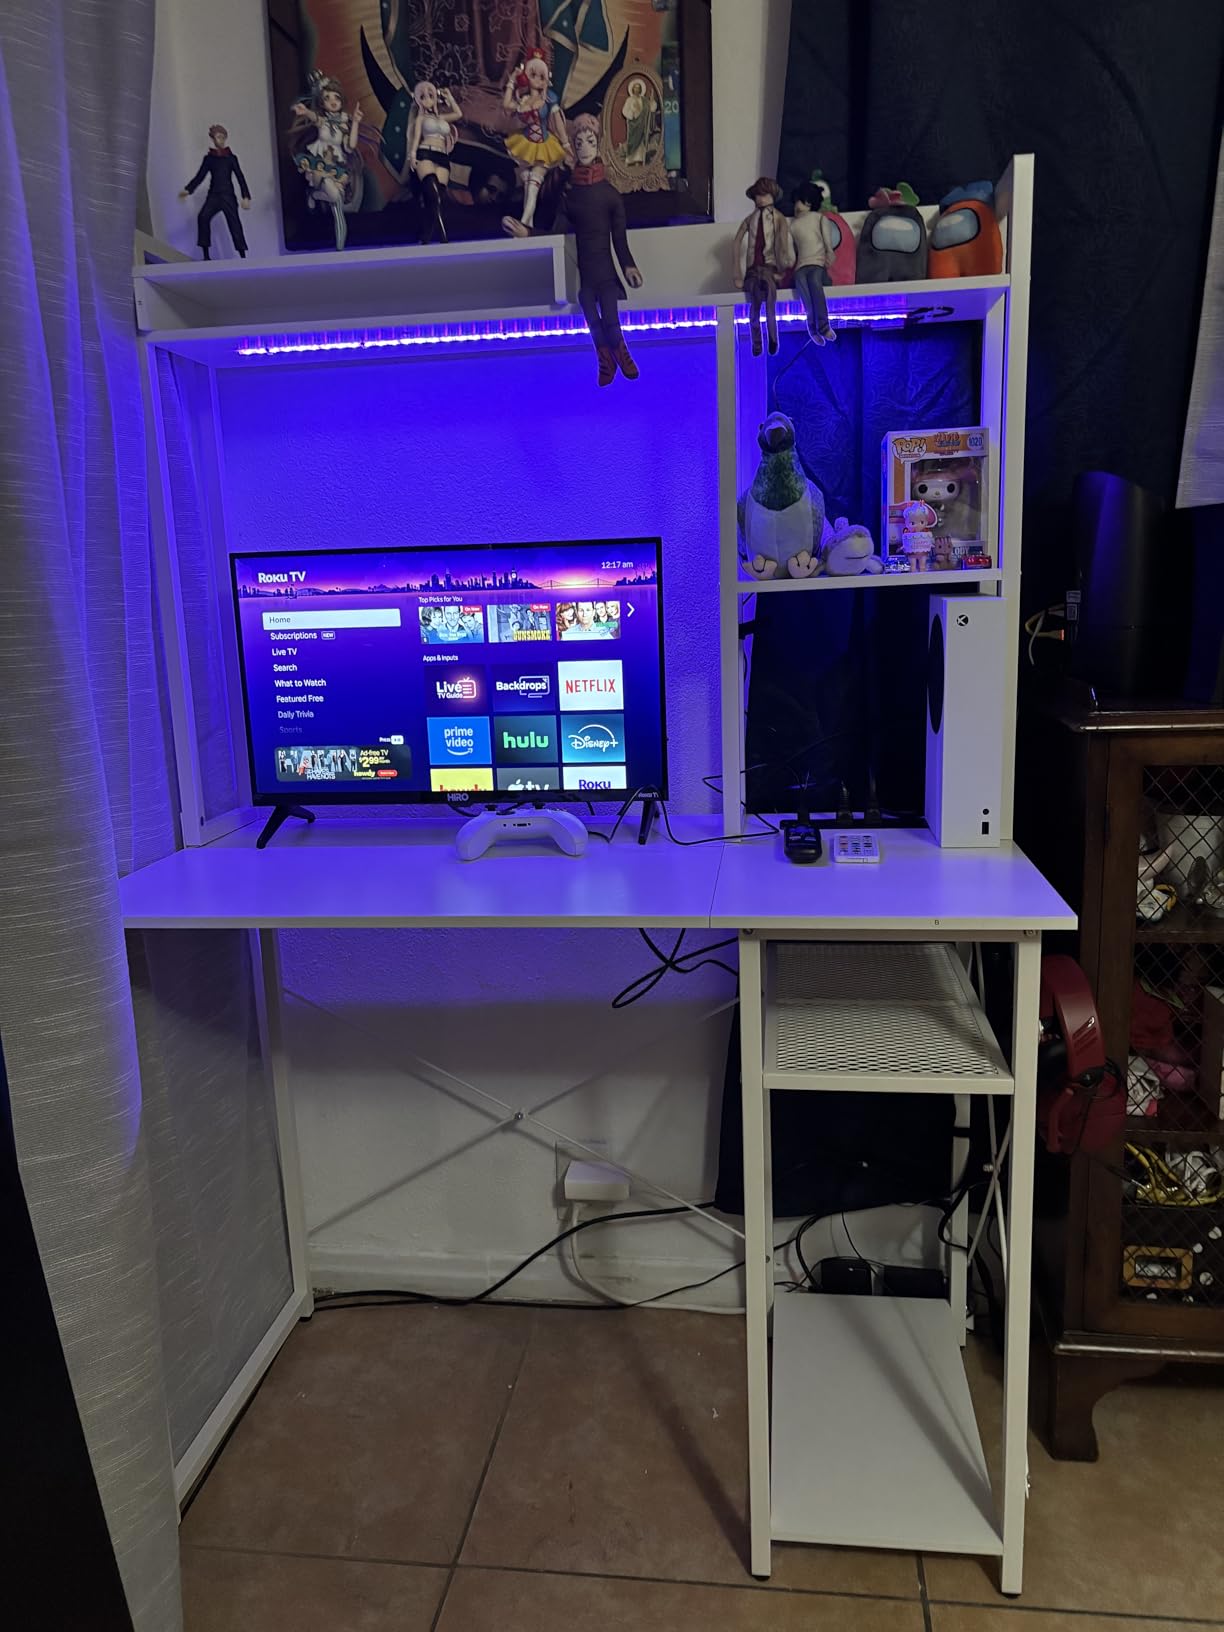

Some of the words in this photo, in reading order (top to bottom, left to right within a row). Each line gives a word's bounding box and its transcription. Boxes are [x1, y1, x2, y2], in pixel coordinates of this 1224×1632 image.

[892, 438, 926, 454] POP!
[601, 561, 621, 569] 12:17
[258, 573, 288, 583] Roku
[289, 571, 306, 582] TV
[418, 596, 428, 604] Top
[269, 616, 291, 624] Home
[270, 632, 318, 641] Subscriptions
[271, 648, 287, 656] Live
[287, 647, 297, 655] TV
[441, 654, 459, 662] Inputs
[273, 664, 298, 672] Search
[275, 679, 294, 687] What
[303, 678, 327, 687] Watch
[436, 681, 462, 693] Live
[496, 681, 547, 691] Backdrops
[565, 679, 616, 694] NETFLIX
[276, 695, 307, 703] Featured
[308, 694, 324, 702] Free
[277, 710, 295, 719] Daily
[295, 710, 314, 718] Trivia
[279, 726, 303, 734] Sports
[444, 726, 474, 739] prime
[445, 737, 474, 747] video
[503, 731, 549, 748] hulu
[568, 734, 619, 753] Disney+
[579, 779, 611, 789] Roku
[447, 792, 469, 801] HIRO
